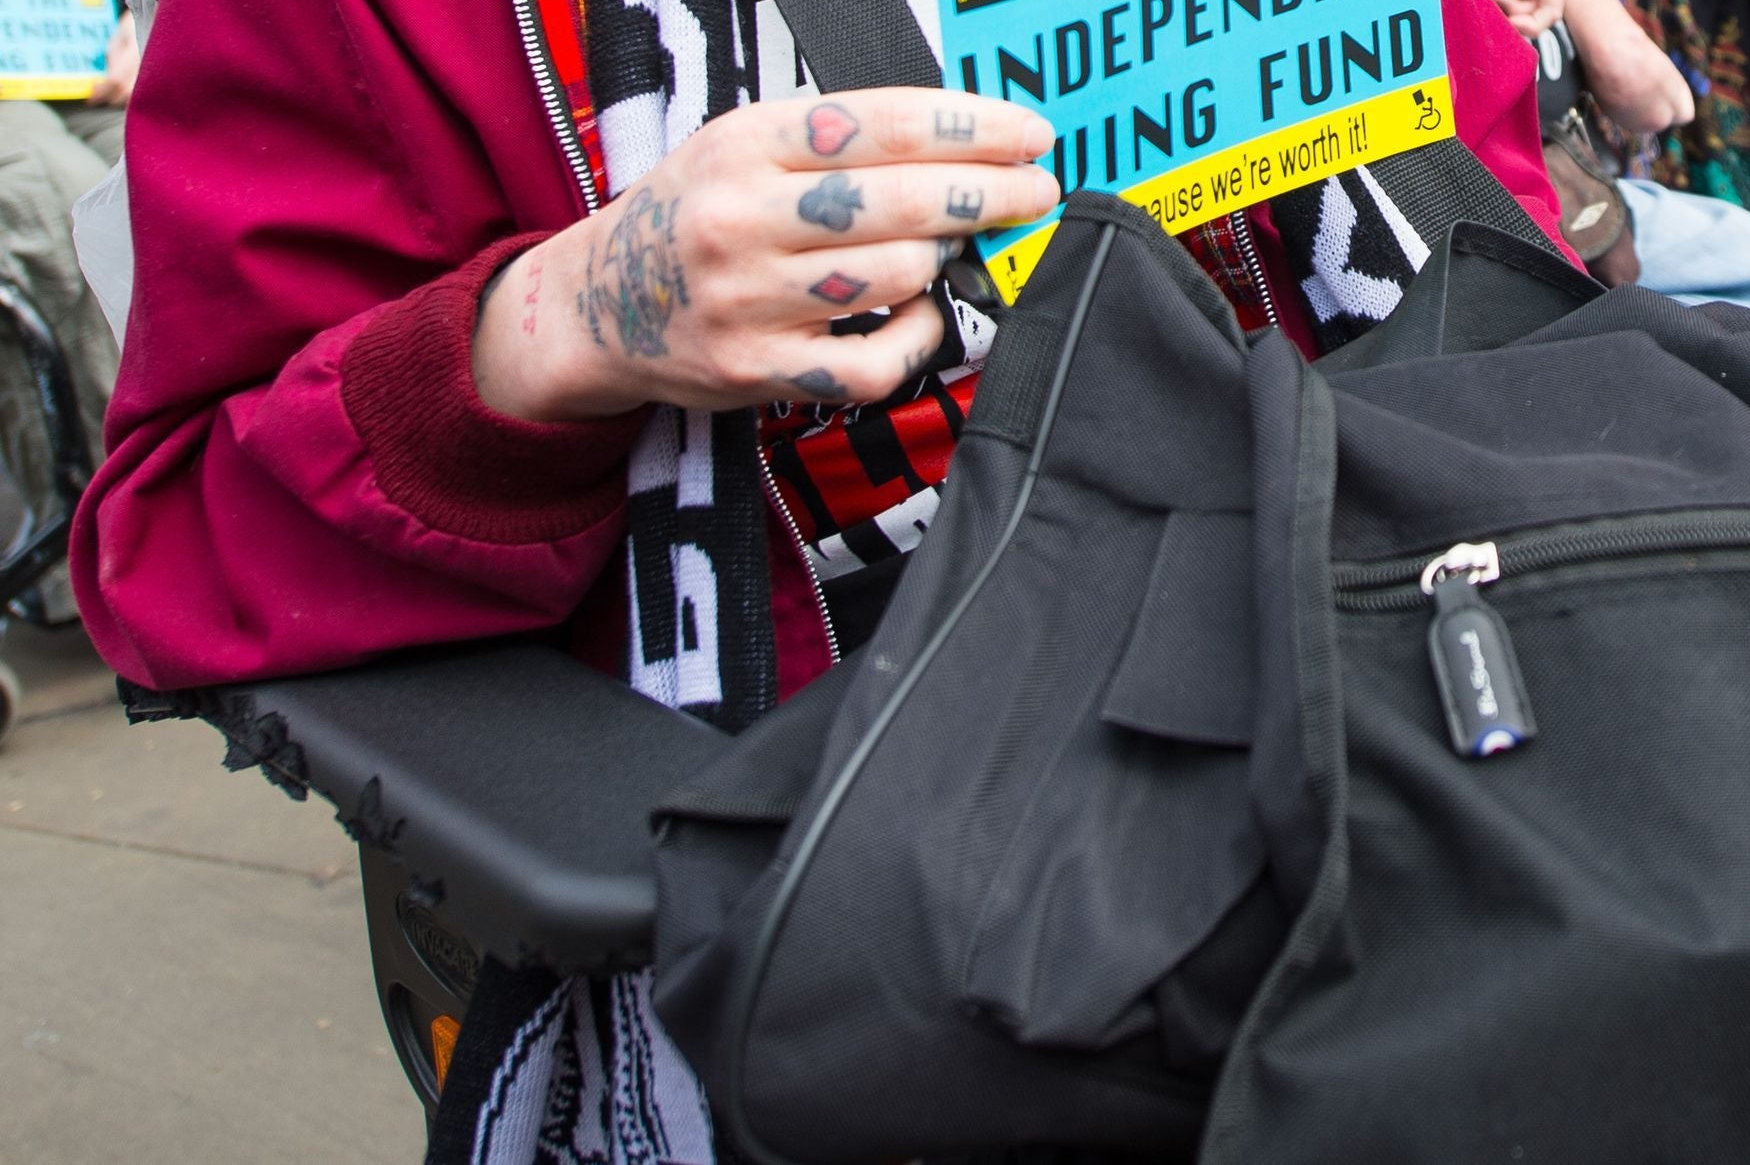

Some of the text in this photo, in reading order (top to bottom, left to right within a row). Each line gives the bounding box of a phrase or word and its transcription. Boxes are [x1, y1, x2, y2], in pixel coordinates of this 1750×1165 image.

[1054, 9, 1425, 202] VING FUND
[1210, 154, 1273, 204] we're
[1278, 124, 1341, 179] worth
[1348, 112, 1370, 157] it!
